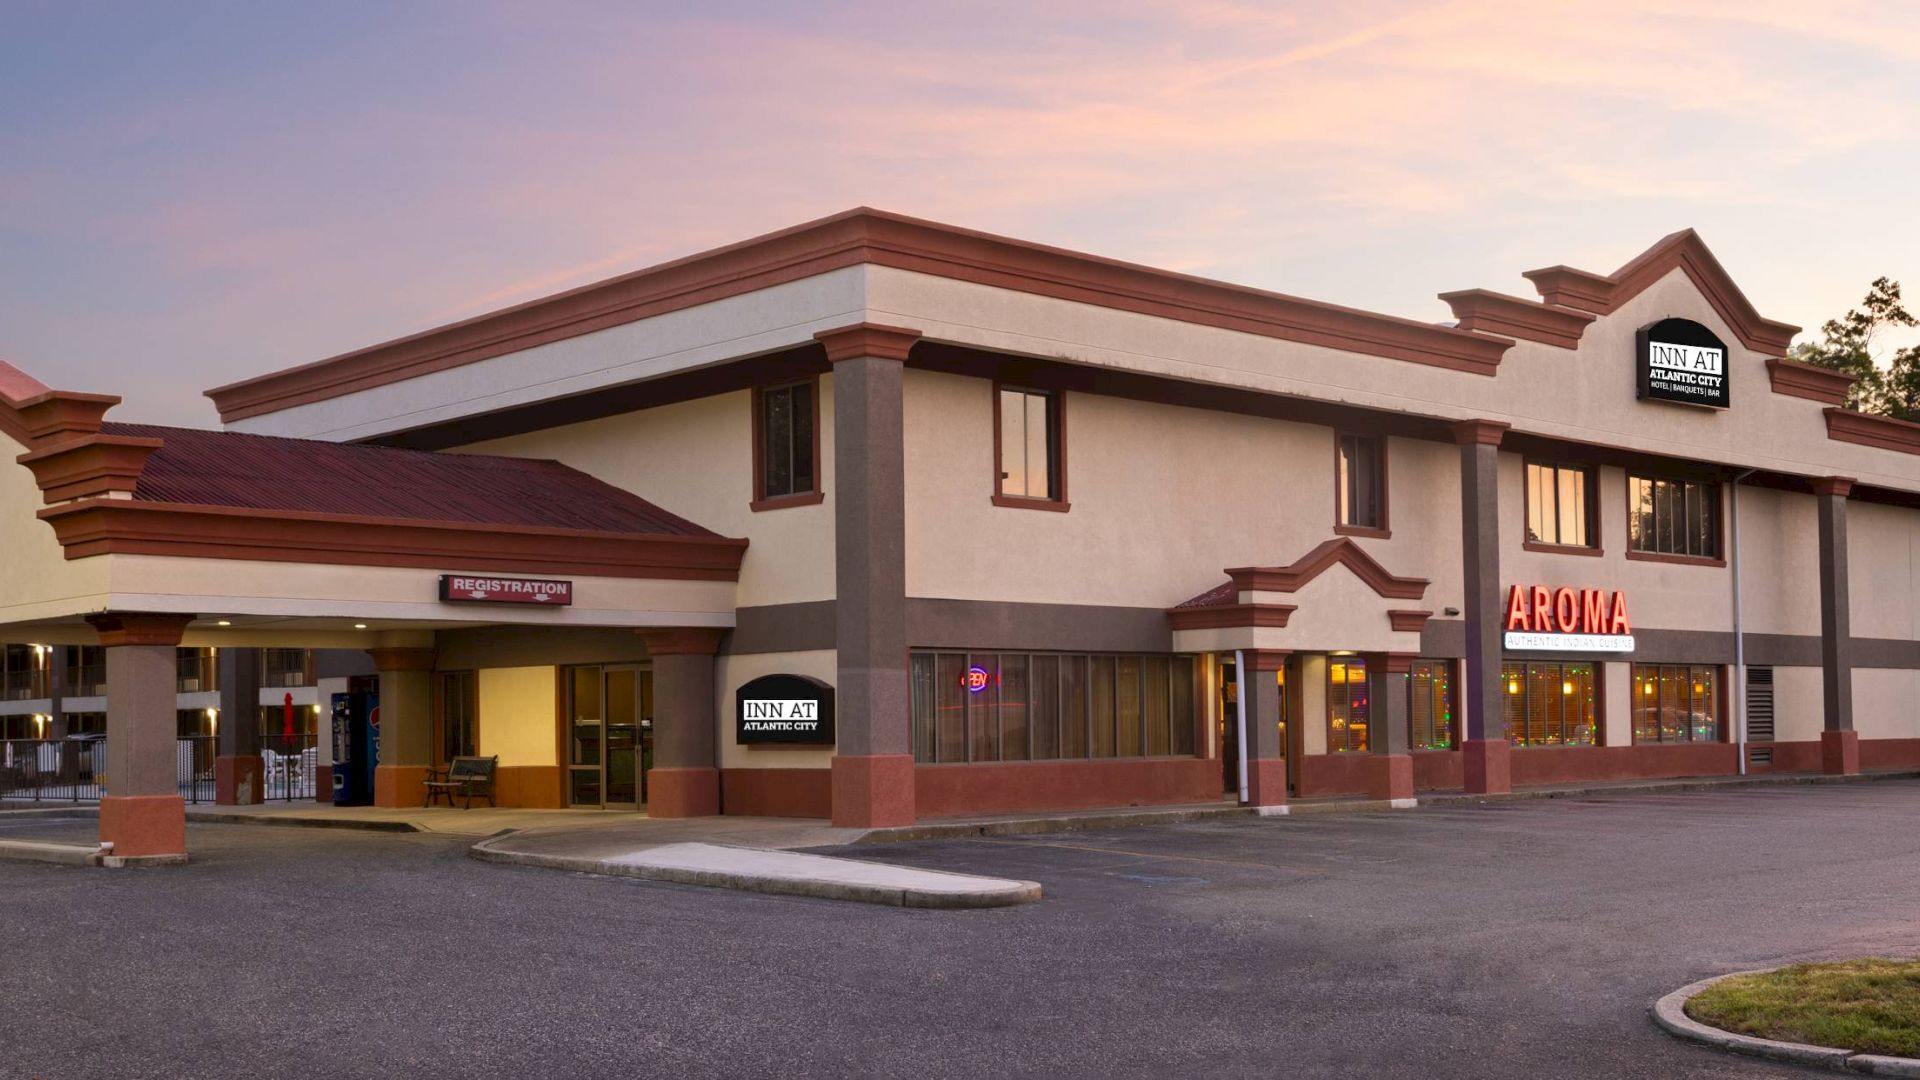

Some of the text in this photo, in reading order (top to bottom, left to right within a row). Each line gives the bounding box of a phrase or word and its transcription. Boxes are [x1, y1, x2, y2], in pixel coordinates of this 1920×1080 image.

[1652, 346, 1719, 371] INN AT
[1650, 369, 1722, 387] ATLANTIC CITY
[453, 577, 567, 595] REGISTRATION
[1506, 584, 1632, 635] AROMA
[1507, 635, 1633, 649] AUTHENTIC INDIAN CUISINE
[746, 702, 815, 718] INN AT
[743, 722, 818, 730] ATLANTIC CITY
